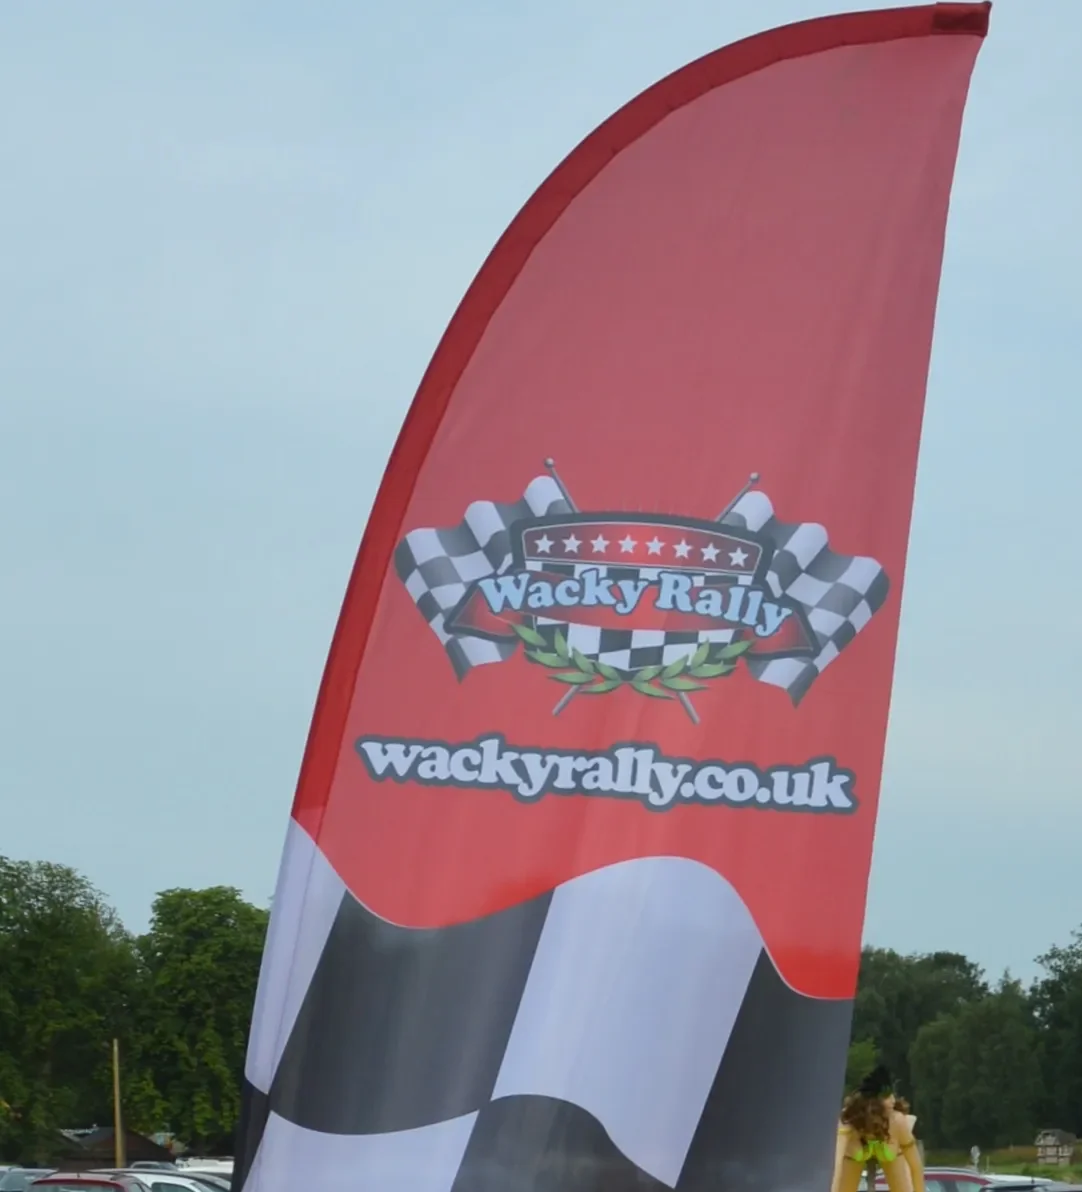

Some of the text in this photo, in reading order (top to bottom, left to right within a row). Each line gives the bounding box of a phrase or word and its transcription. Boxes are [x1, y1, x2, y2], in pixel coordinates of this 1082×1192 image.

[478, 568, 793, 637] Wacky Rally
[359, 737, 855, 812] wackyrally.co.uk
